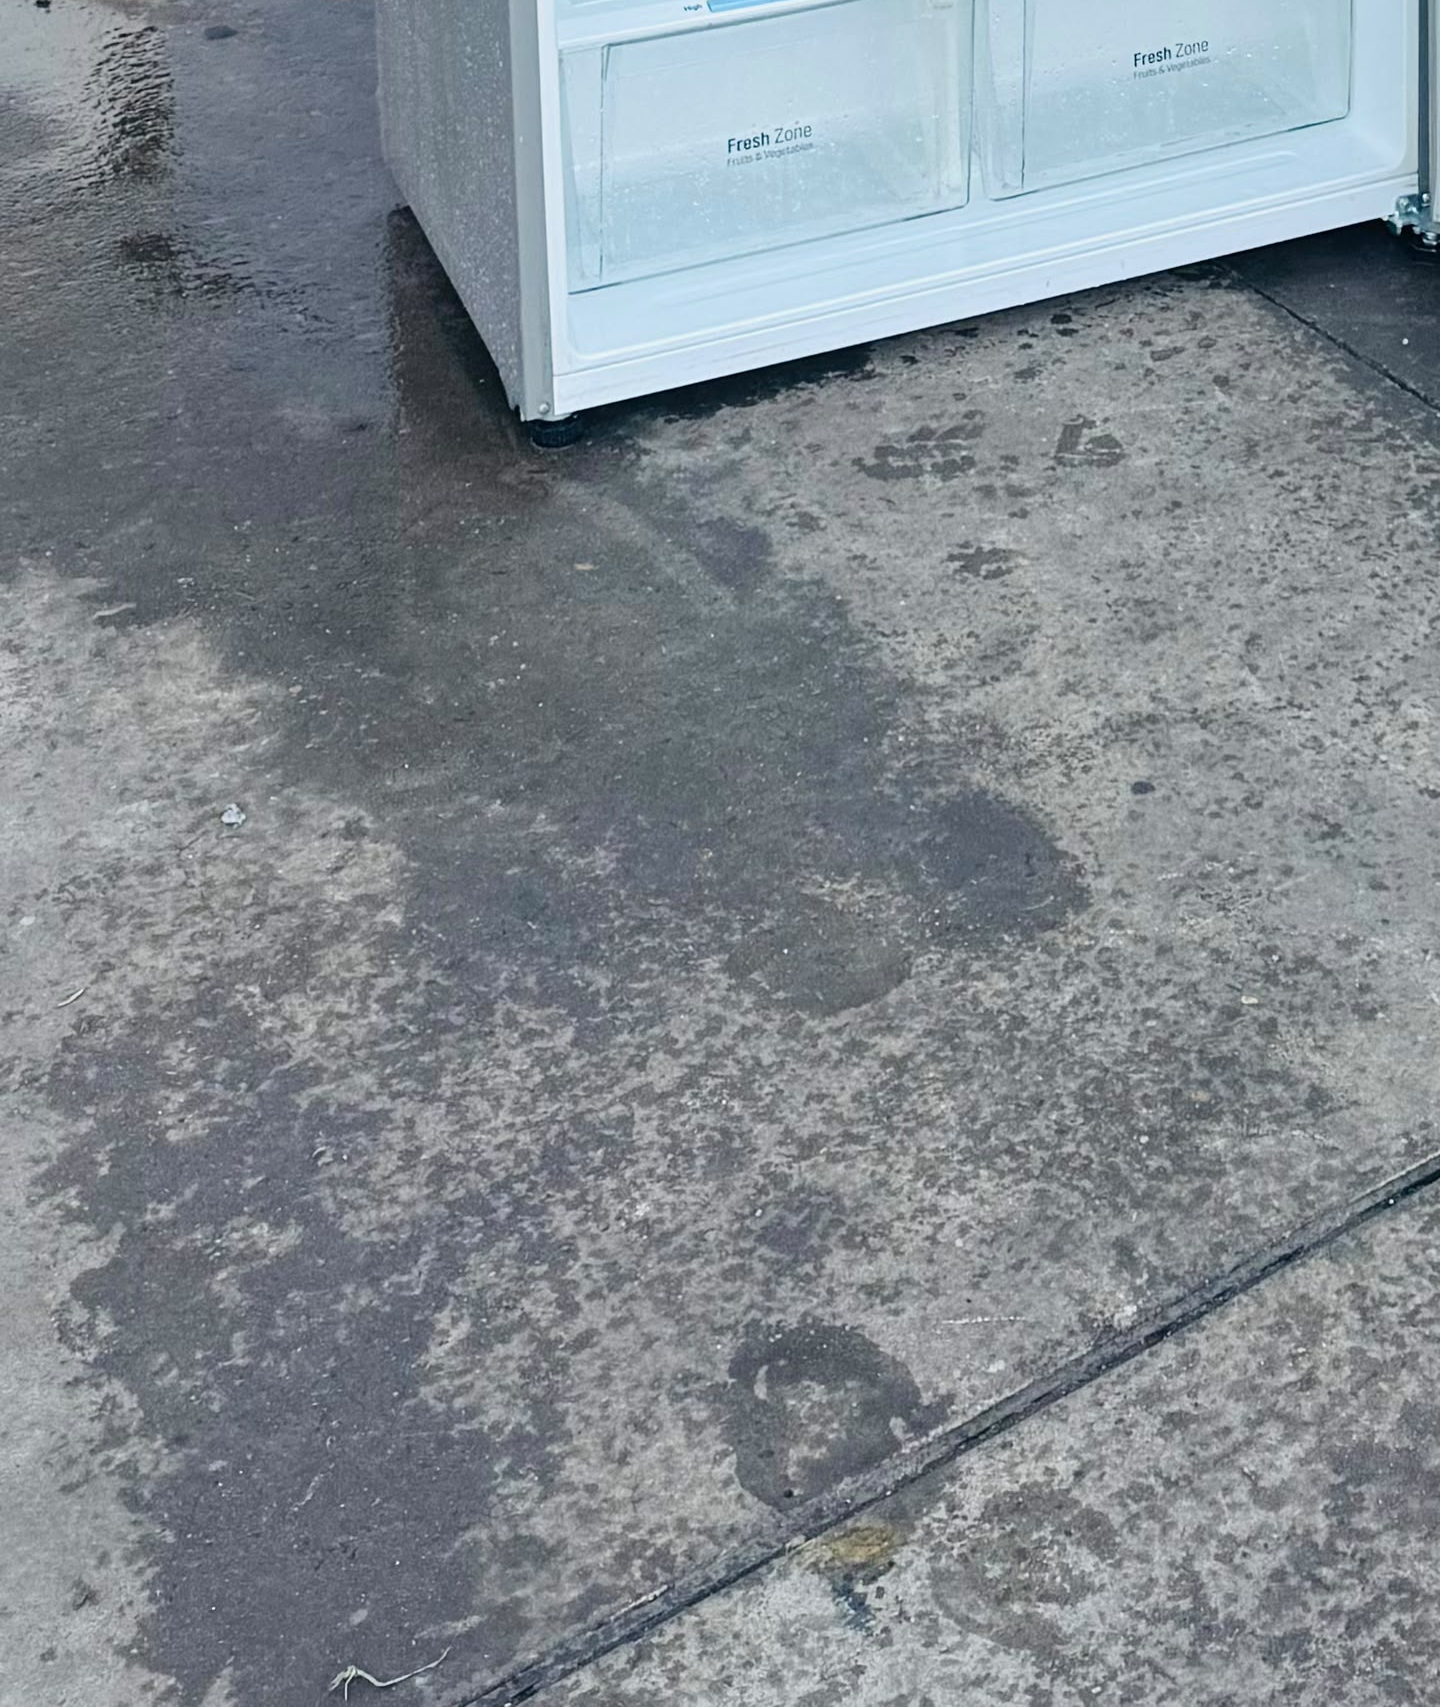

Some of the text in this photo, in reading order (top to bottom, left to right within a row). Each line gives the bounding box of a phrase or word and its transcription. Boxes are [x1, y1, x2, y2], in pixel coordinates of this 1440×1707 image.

[683, 3, 704, 13] High
[1133, 39, 1209, 68] Fresh Zone
[1133, 56, 1211, 80] Fruits & Vegetables
[727, 124, 813, 154] Fresh Zone
[726, 141, 814, 167] Fruits & Vegetables
